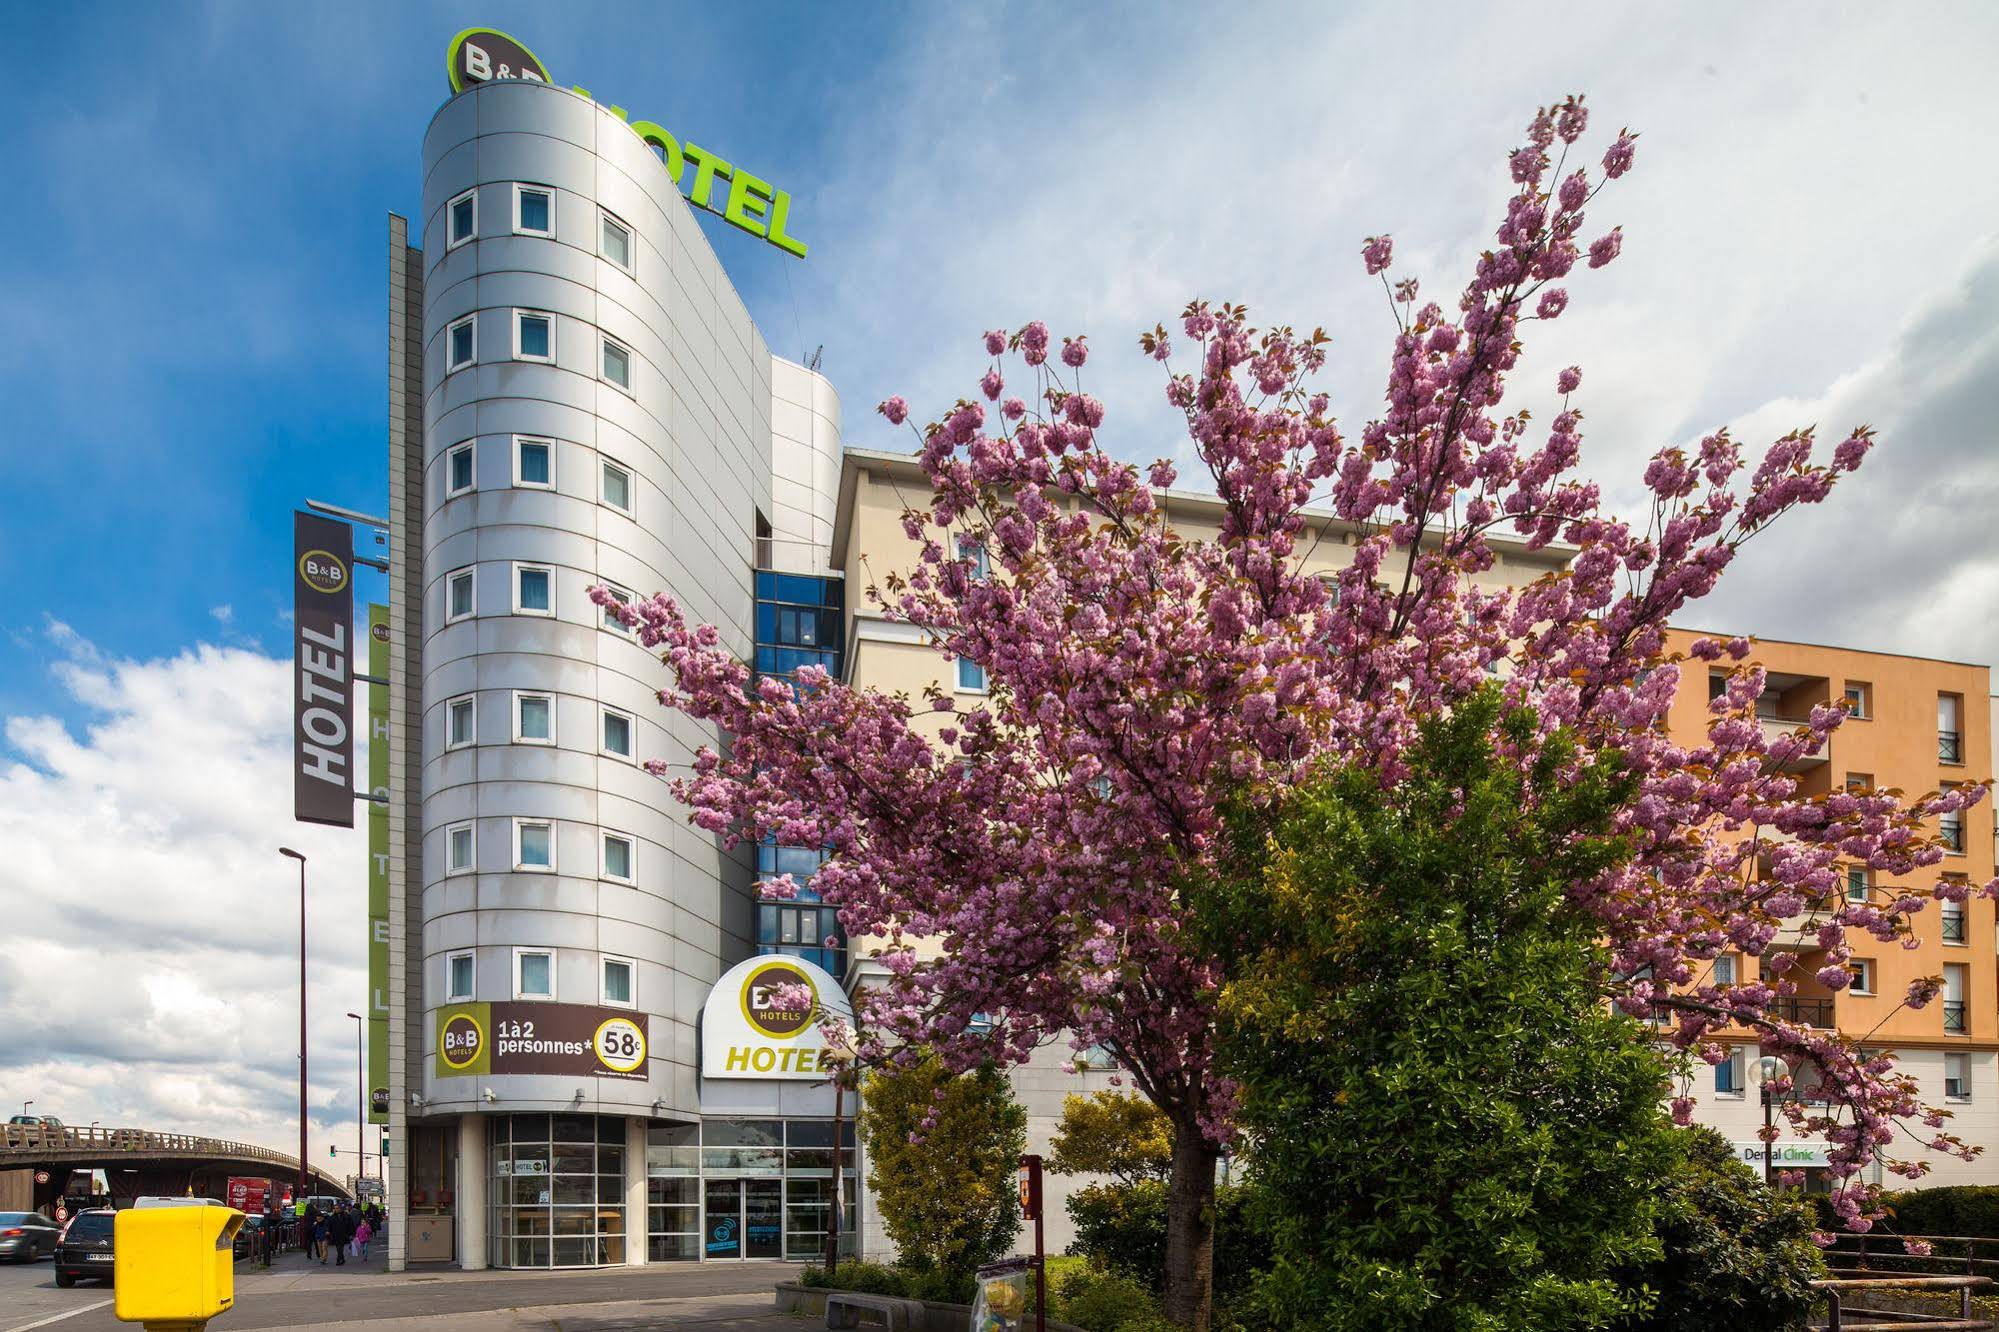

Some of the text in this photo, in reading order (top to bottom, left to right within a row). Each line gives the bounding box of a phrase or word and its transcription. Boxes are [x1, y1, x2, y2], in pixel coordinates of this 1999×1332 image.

[572, 84, 809, 260] OTEL
[306, 560, 342, 580] B&B
[302, 623, 347, 788] HOTEL
[760, 1011, 801, 1021] HOTELS
[446, 1030, 478, 1050] B&B
[449, 1048, 473, 1056] HOTELS
[1745, 1147, 1814, 1161] Denal Clinic
